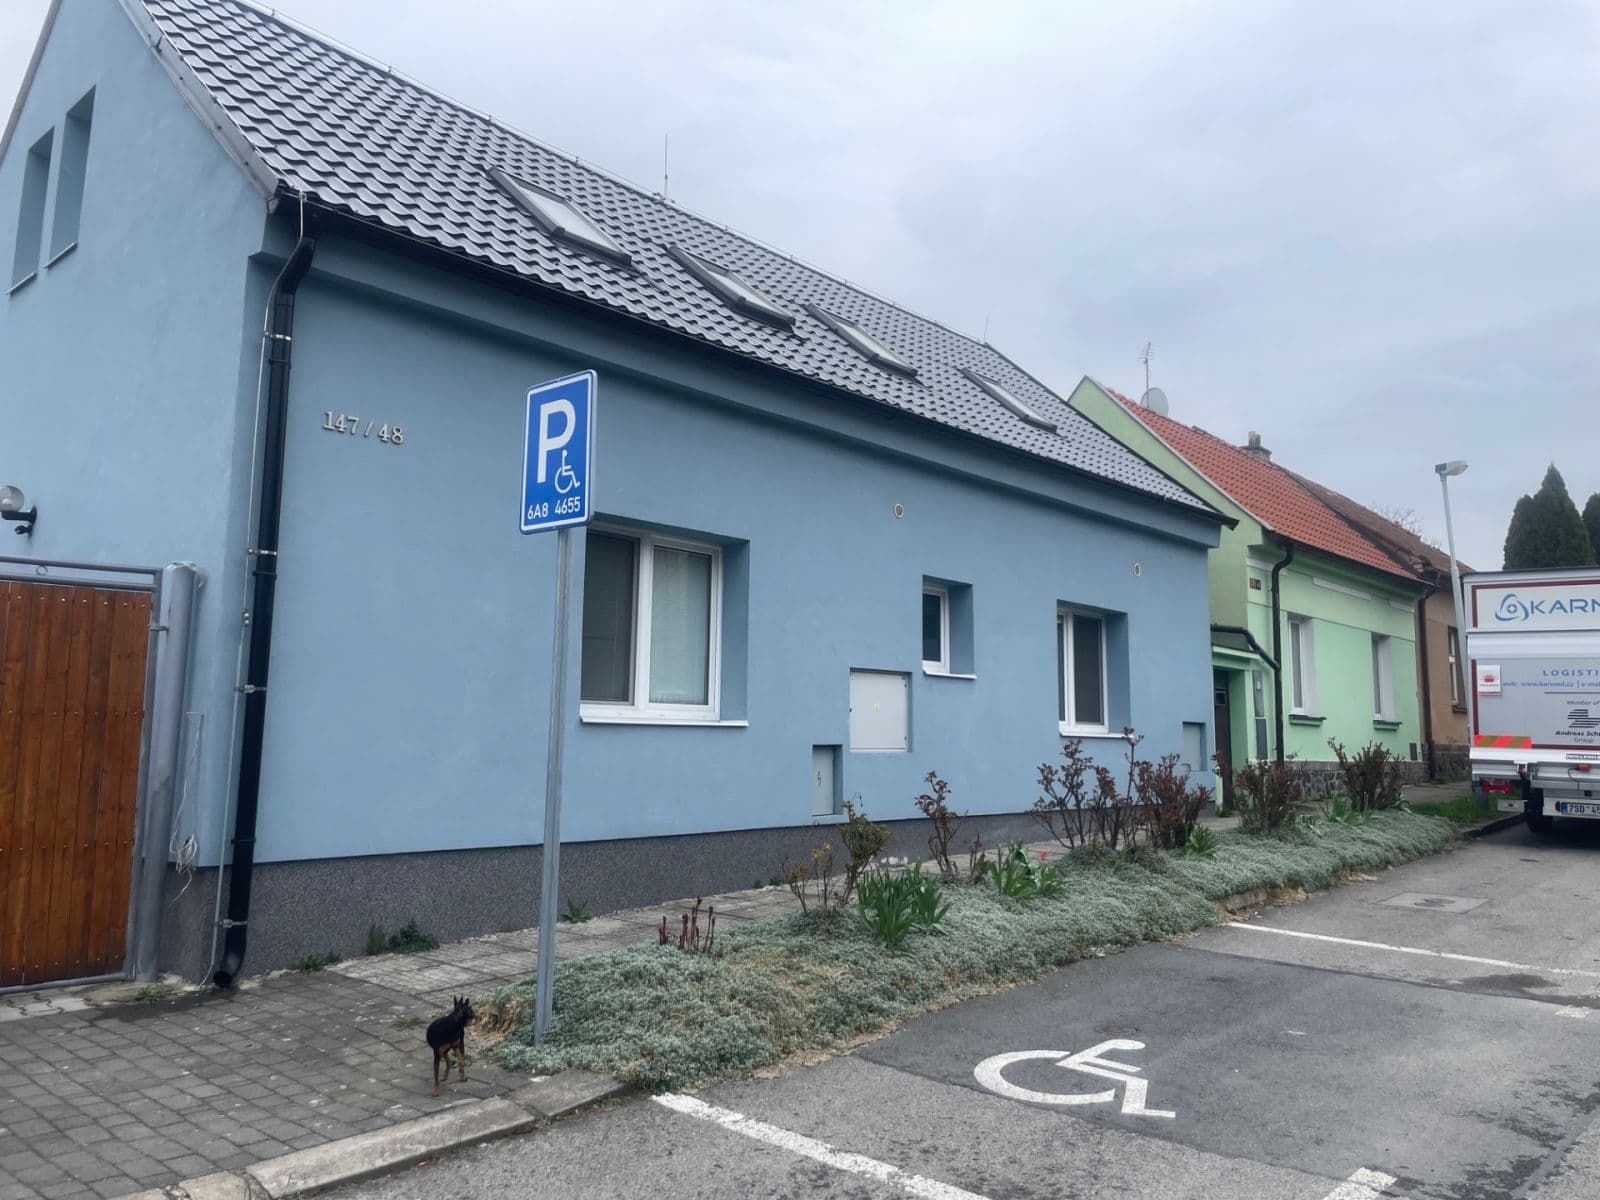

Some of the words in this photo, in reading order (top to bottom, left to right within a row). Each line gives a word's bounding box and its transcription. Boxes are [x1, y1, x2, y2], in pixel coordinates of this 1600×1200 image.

[537, 398, 577, 484] P
[527, 502, 549, 520] 6A8
[554, 496, 581, 515] 4655
